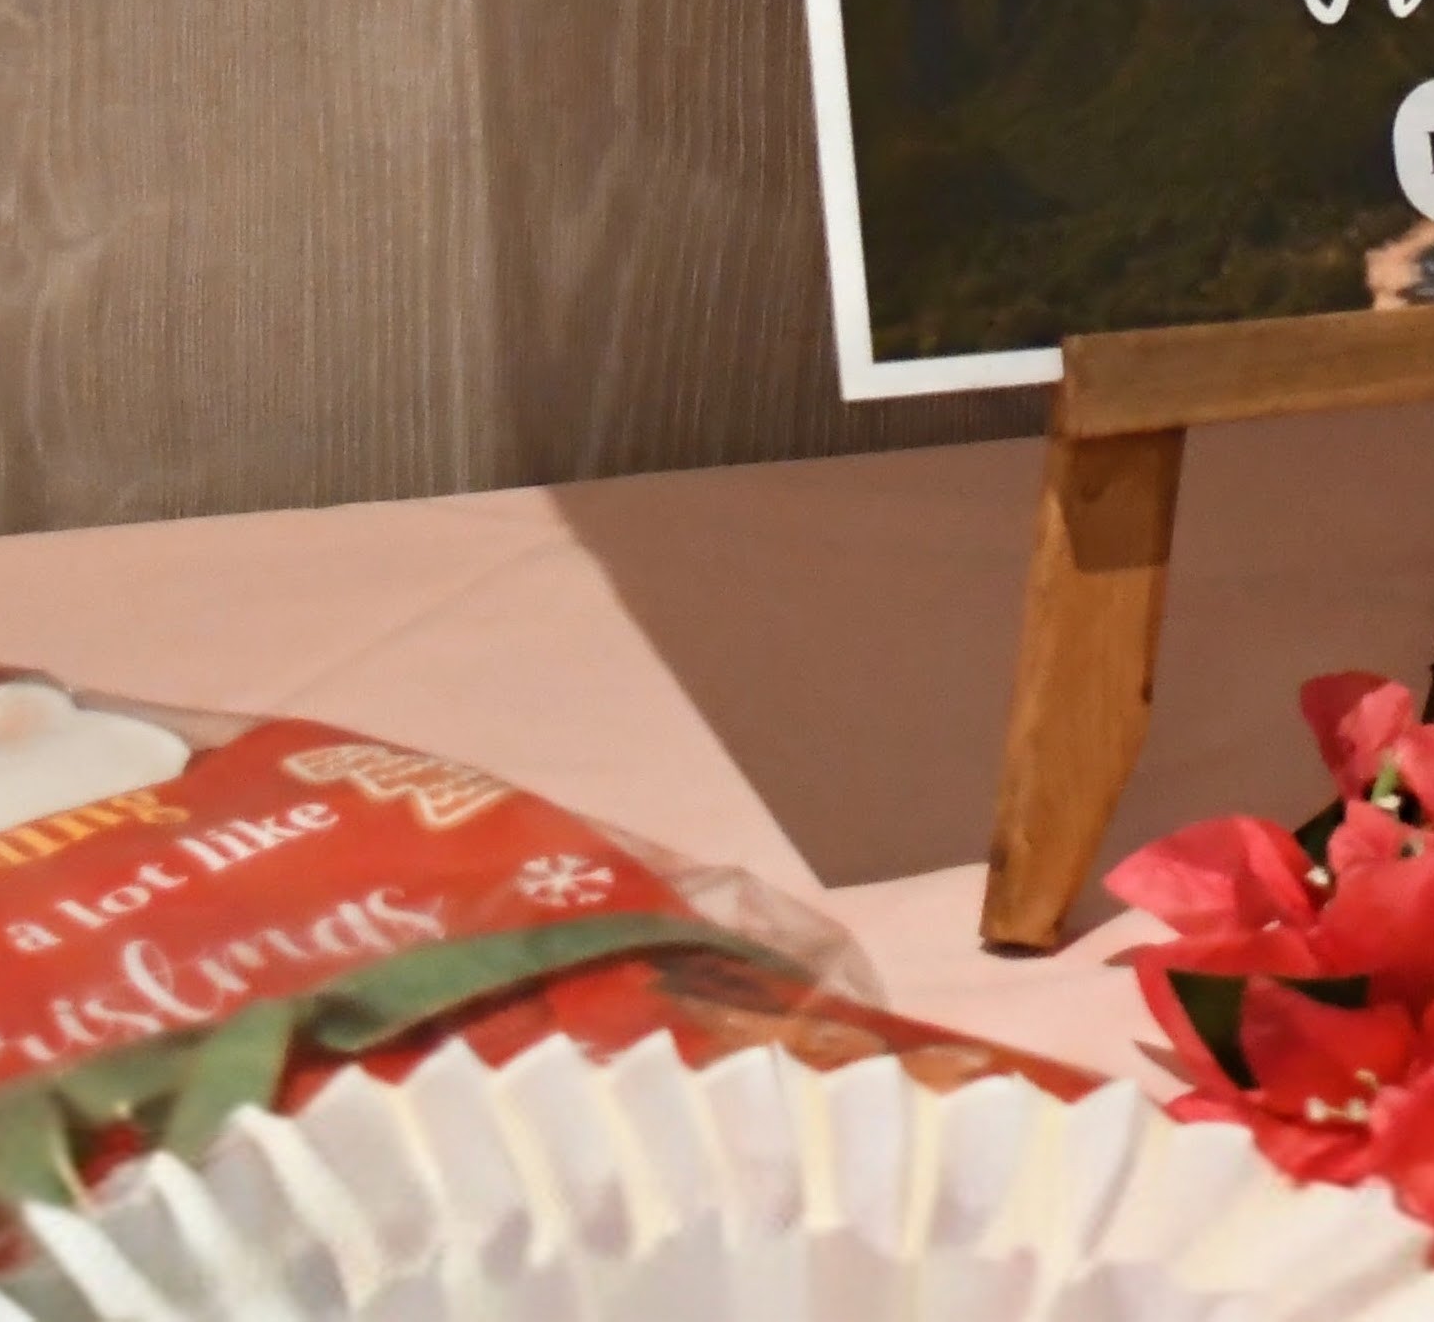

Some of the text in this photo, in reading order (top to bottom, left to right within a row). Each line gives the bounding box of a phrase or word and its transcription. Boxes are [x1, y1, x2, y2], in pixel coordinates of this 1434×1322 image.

[6, 919, 62, 950] a
[57, 859, 191, 930] lot
[178, 800, 340, 873] like
